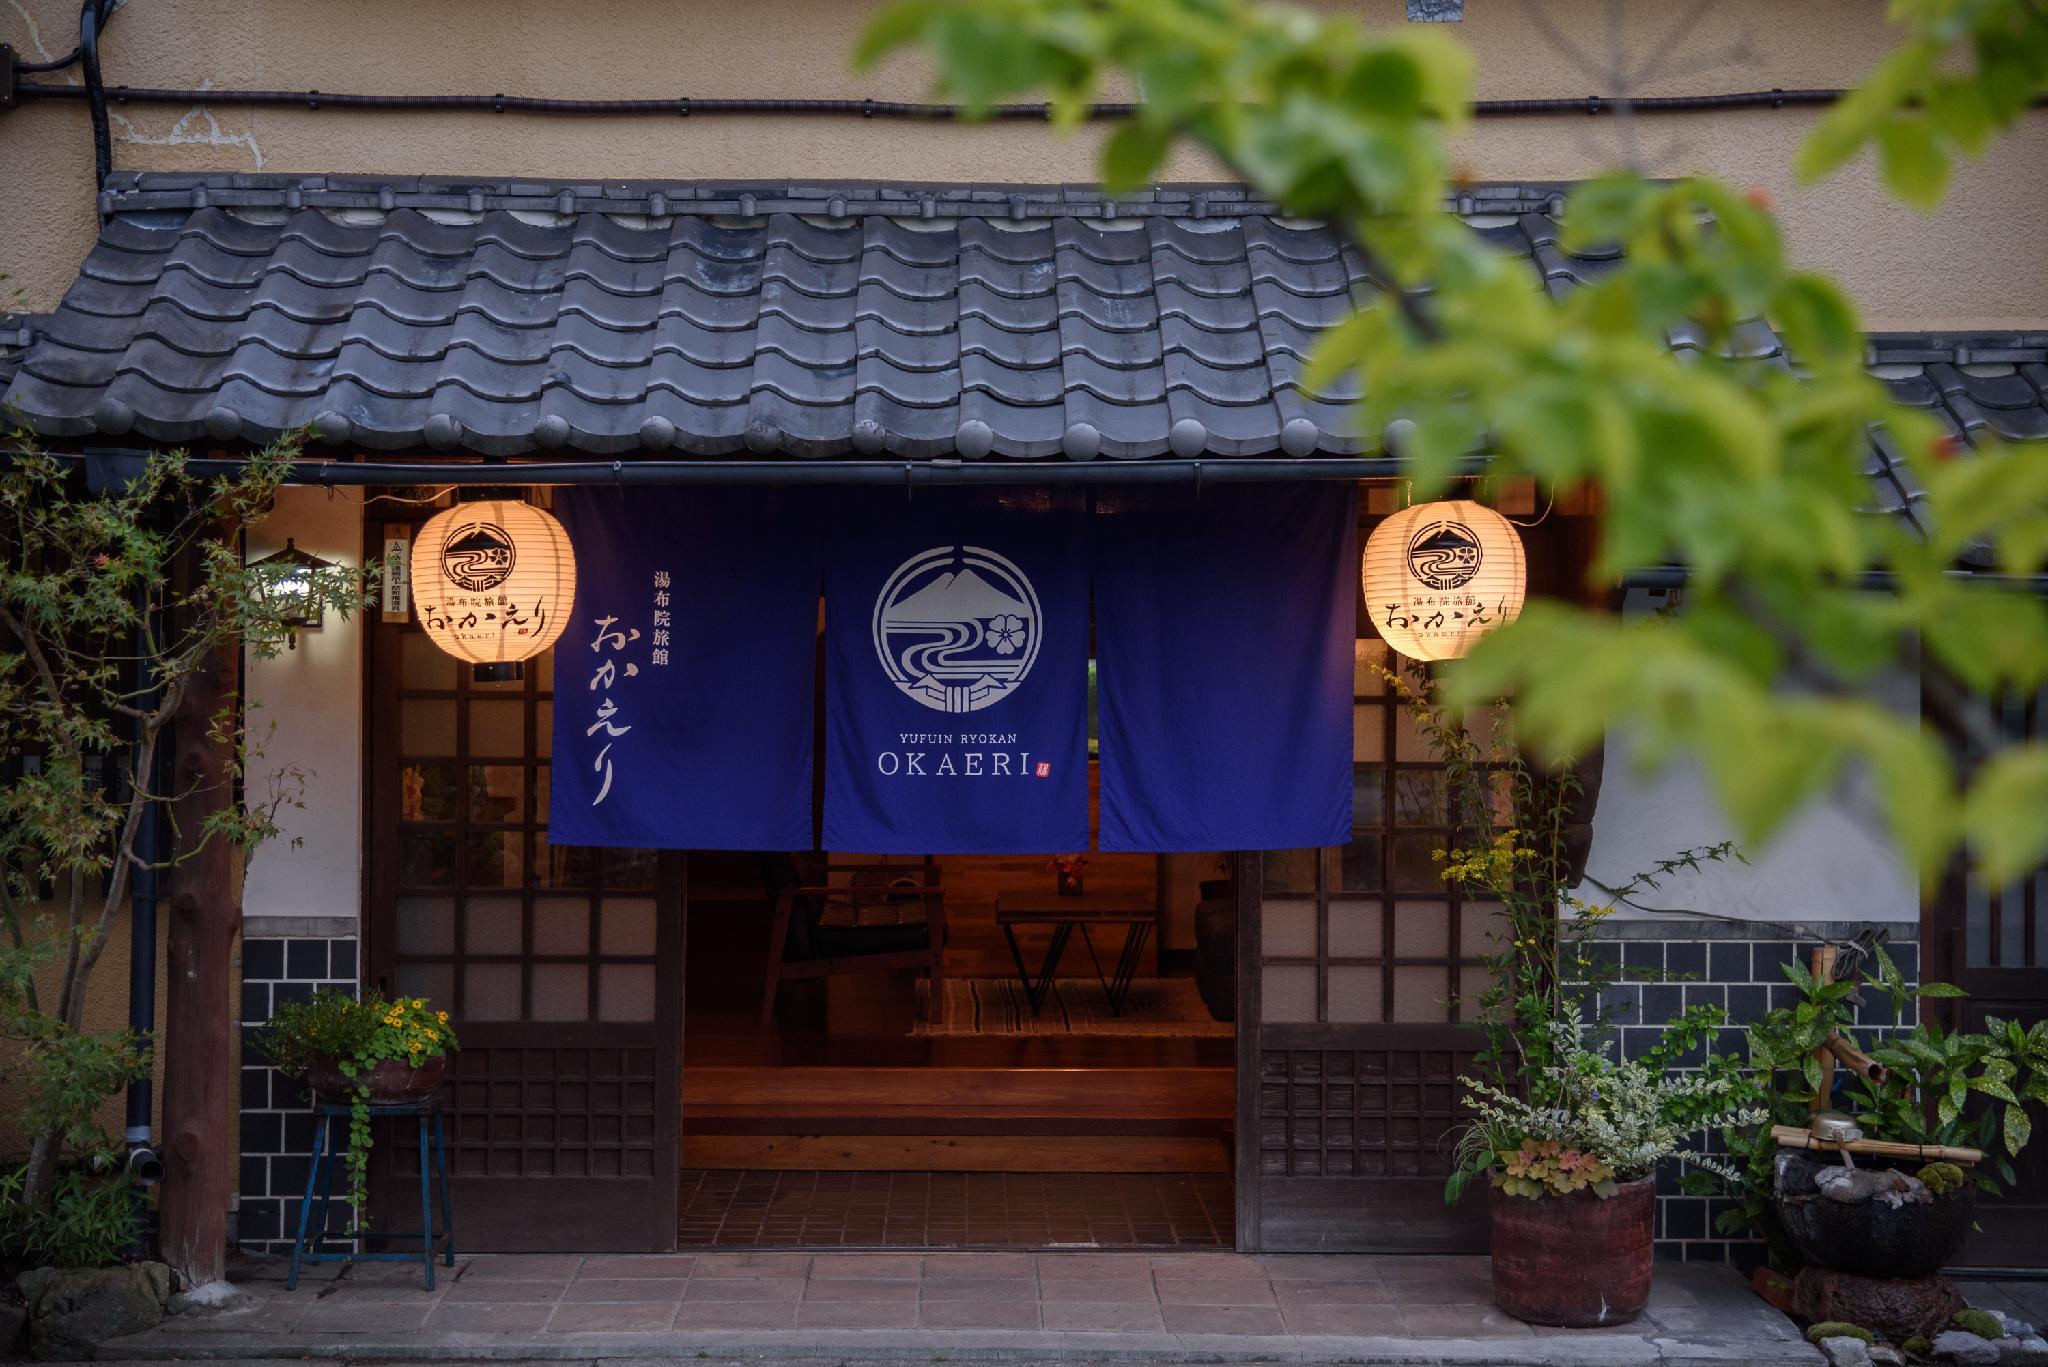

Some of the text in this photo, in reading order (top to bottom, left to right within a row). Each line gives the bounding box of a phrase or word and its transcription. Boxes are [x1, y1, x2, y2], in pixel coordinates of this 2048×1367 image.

[424, 596, 546, 639] おかえり
[652, 571, 671, 666] 湯布院旅館
[586, 615, 641, 806] おかえり
[900, 733, 1017, 744] YUFUIN RYOKAN
[878, 752, 1030, 776] OKAERI
